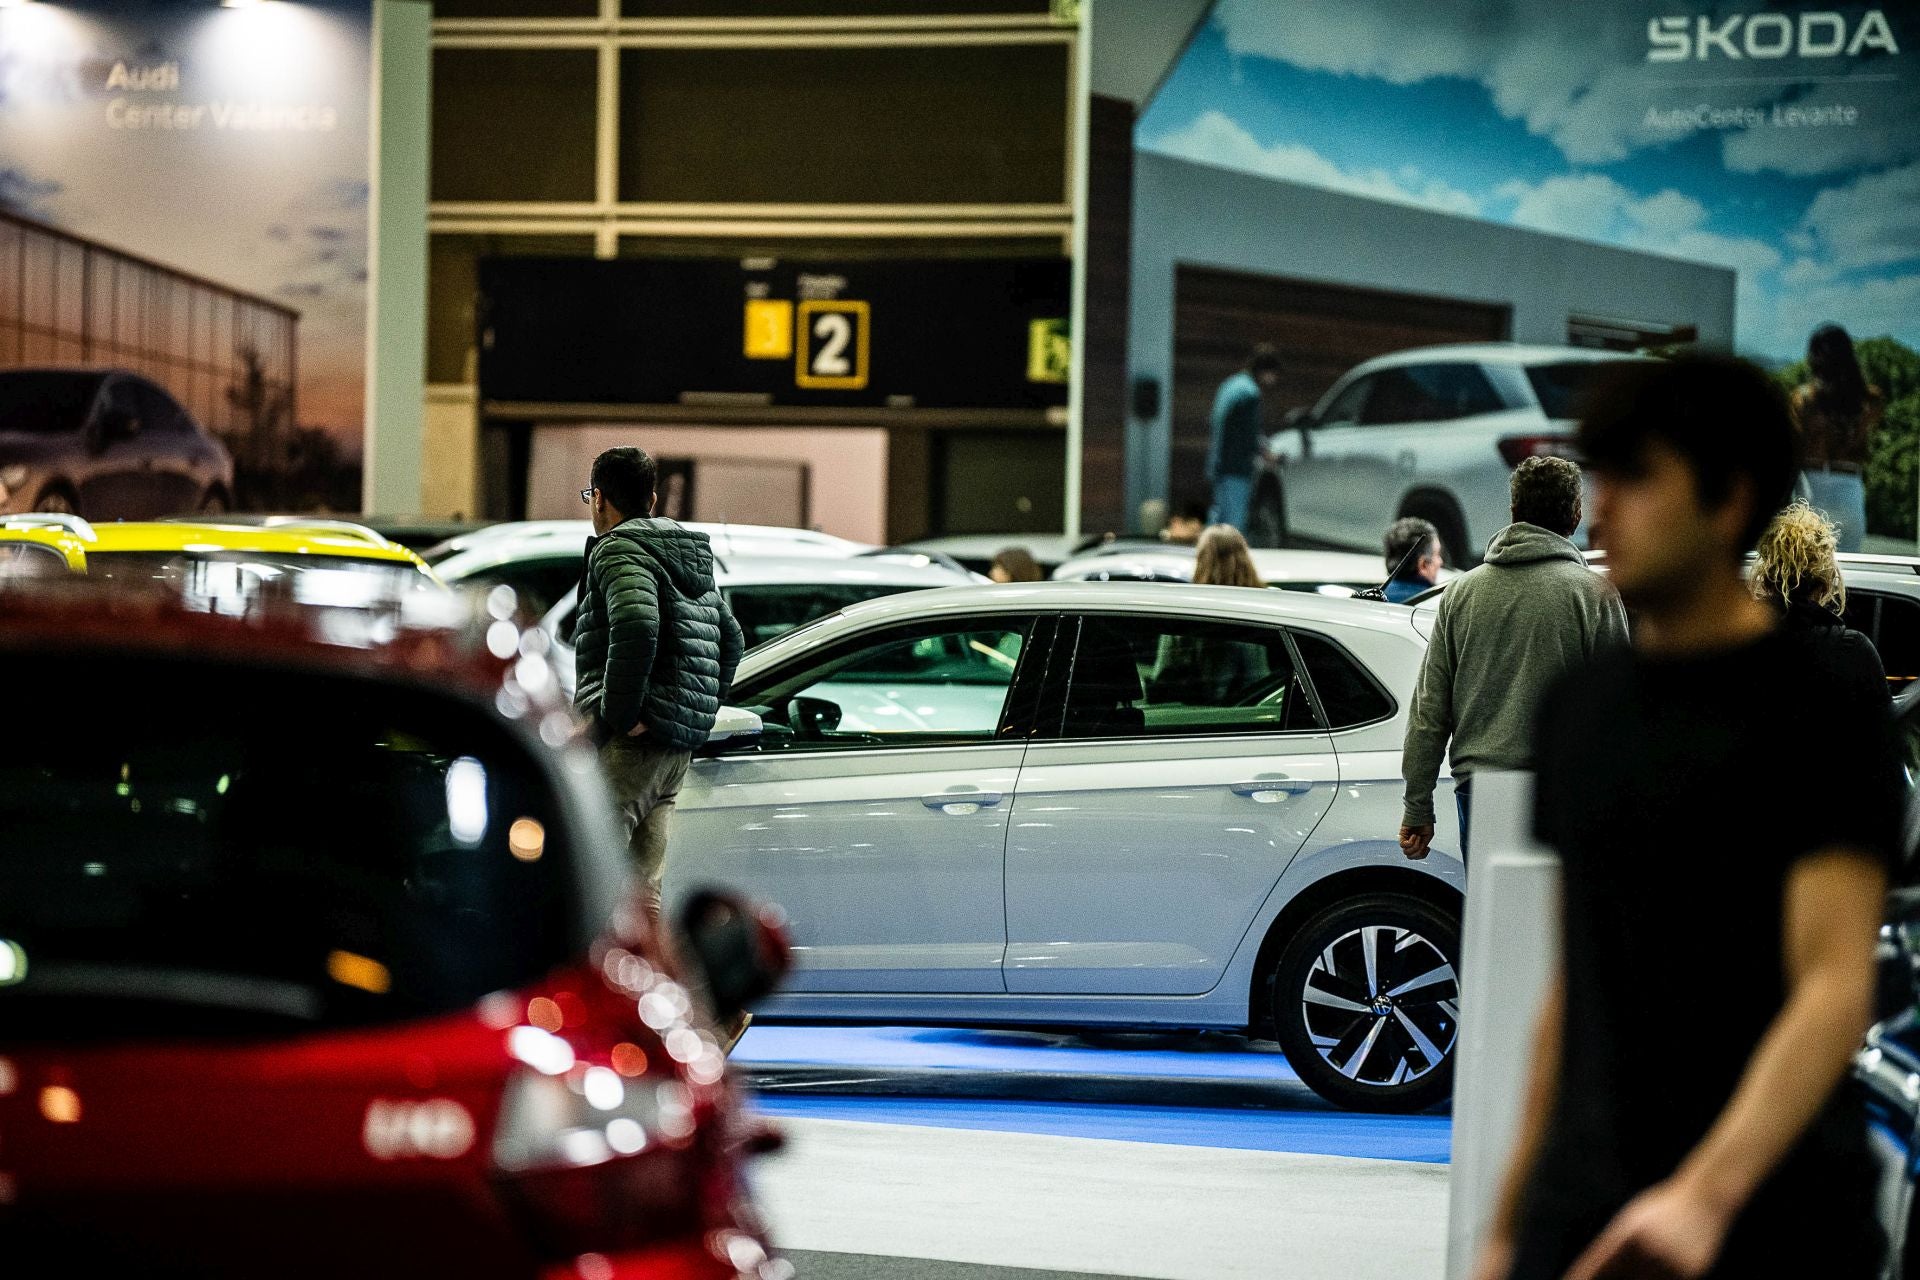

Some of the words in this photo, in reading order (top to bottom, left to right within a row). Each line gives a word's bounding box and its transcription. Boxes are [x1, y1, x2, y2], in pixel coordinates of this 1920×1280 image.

[106, 61, 179, 90] Audi
[106, 98, 204, 129] Center
[1771, 103, 1859, 128] Levante
[812, 312, 851, 375] 2
